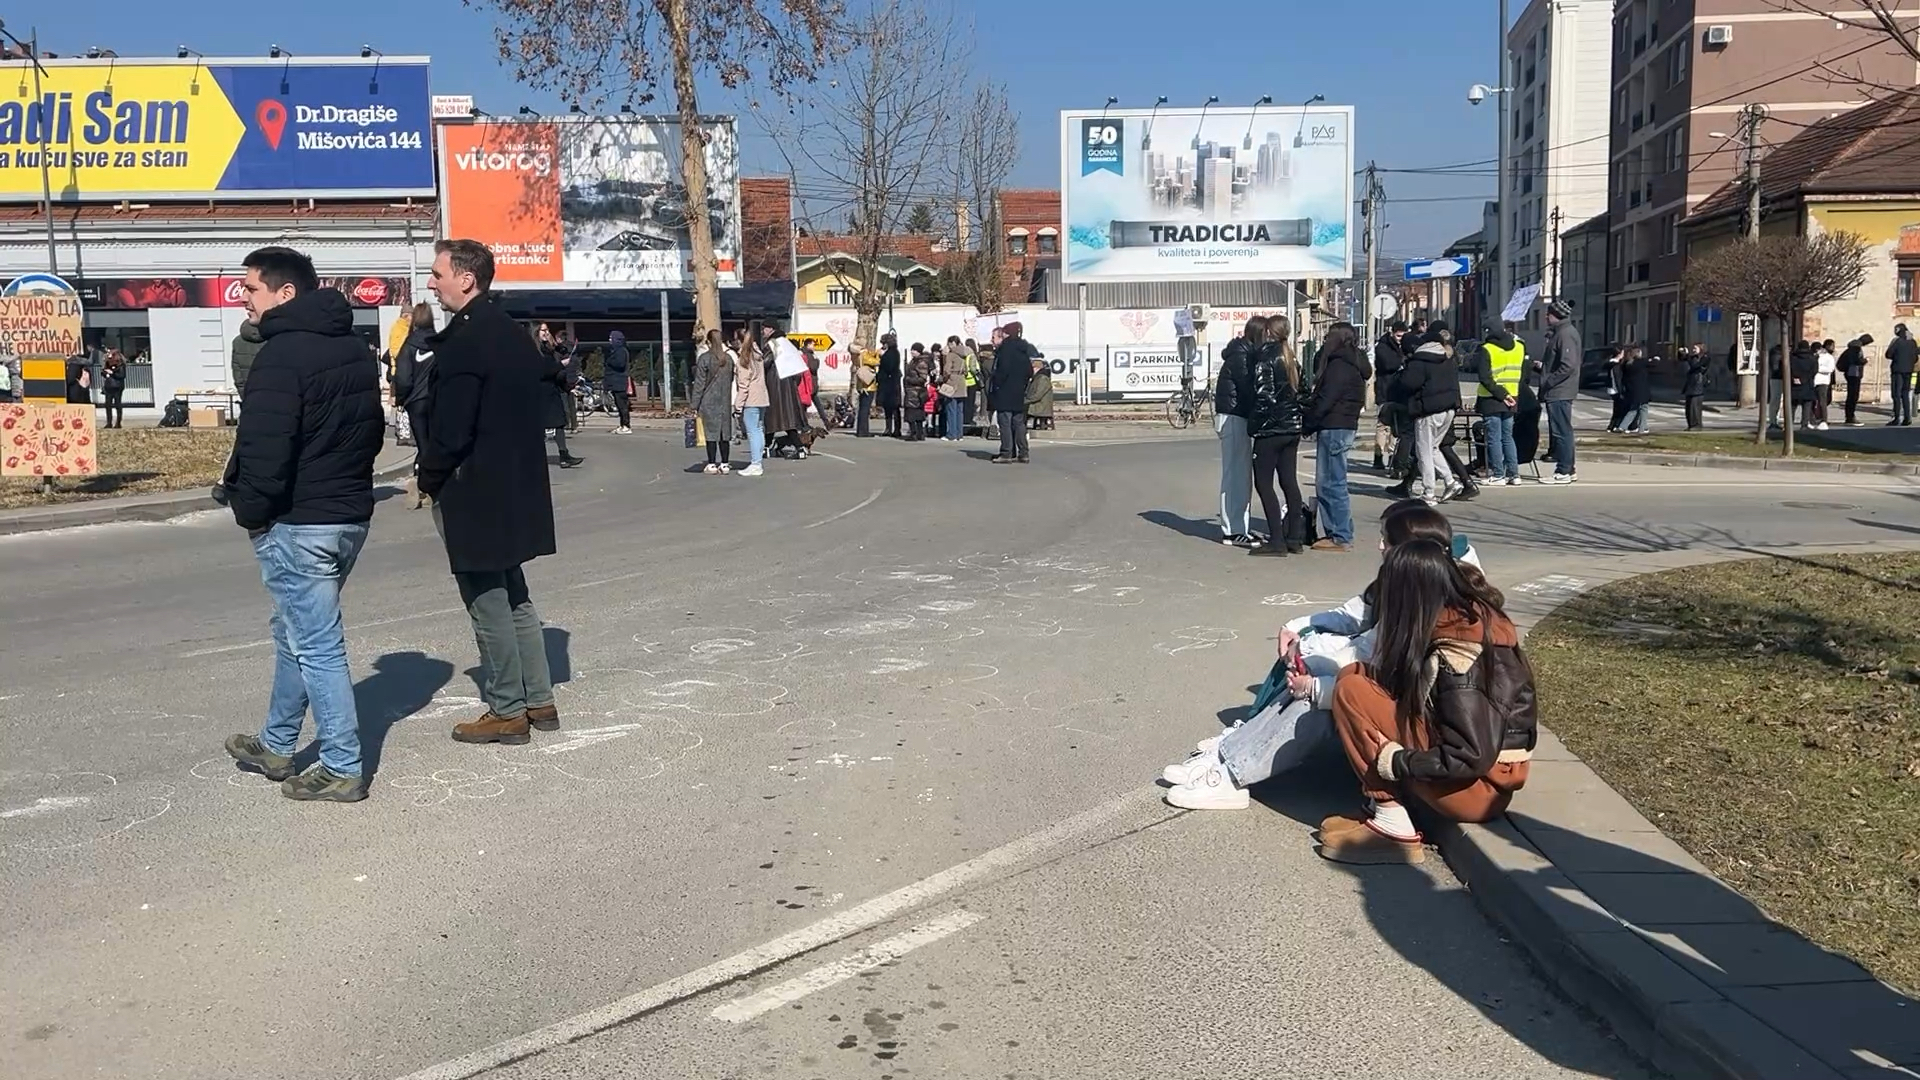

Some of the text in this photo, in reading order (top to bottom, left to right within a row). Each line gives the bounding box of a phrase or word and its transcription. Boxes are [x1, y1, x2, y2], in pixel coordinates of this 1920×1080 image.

[0, 91, 189, 144] adi Sam
[295, 105, 398, 126] Dr.Dragiše
[297, 131, 422, 149] Mišovića 144
[1088, 125, 1117, 145] 50
[15, 147, 66, 168] kuću
[72, 152, 109, 168] sve
[113, 152, 136, 168] za
[141, 149, 188, 168] stan
[455, 146, 551, 177] vitorog
[1087, 149, 1118, 157] GODINA
[1149, 223, 1271, 243] TRADICIJA
[483, 242, 520, 253] obna
[1157, 247, 1259, 259] kvaliteta i poverenja
[57, 299, 80, 317] ДА
[0, 317, 49, 331] БИСМО
[1050, 358, 1100, 375] ORT
